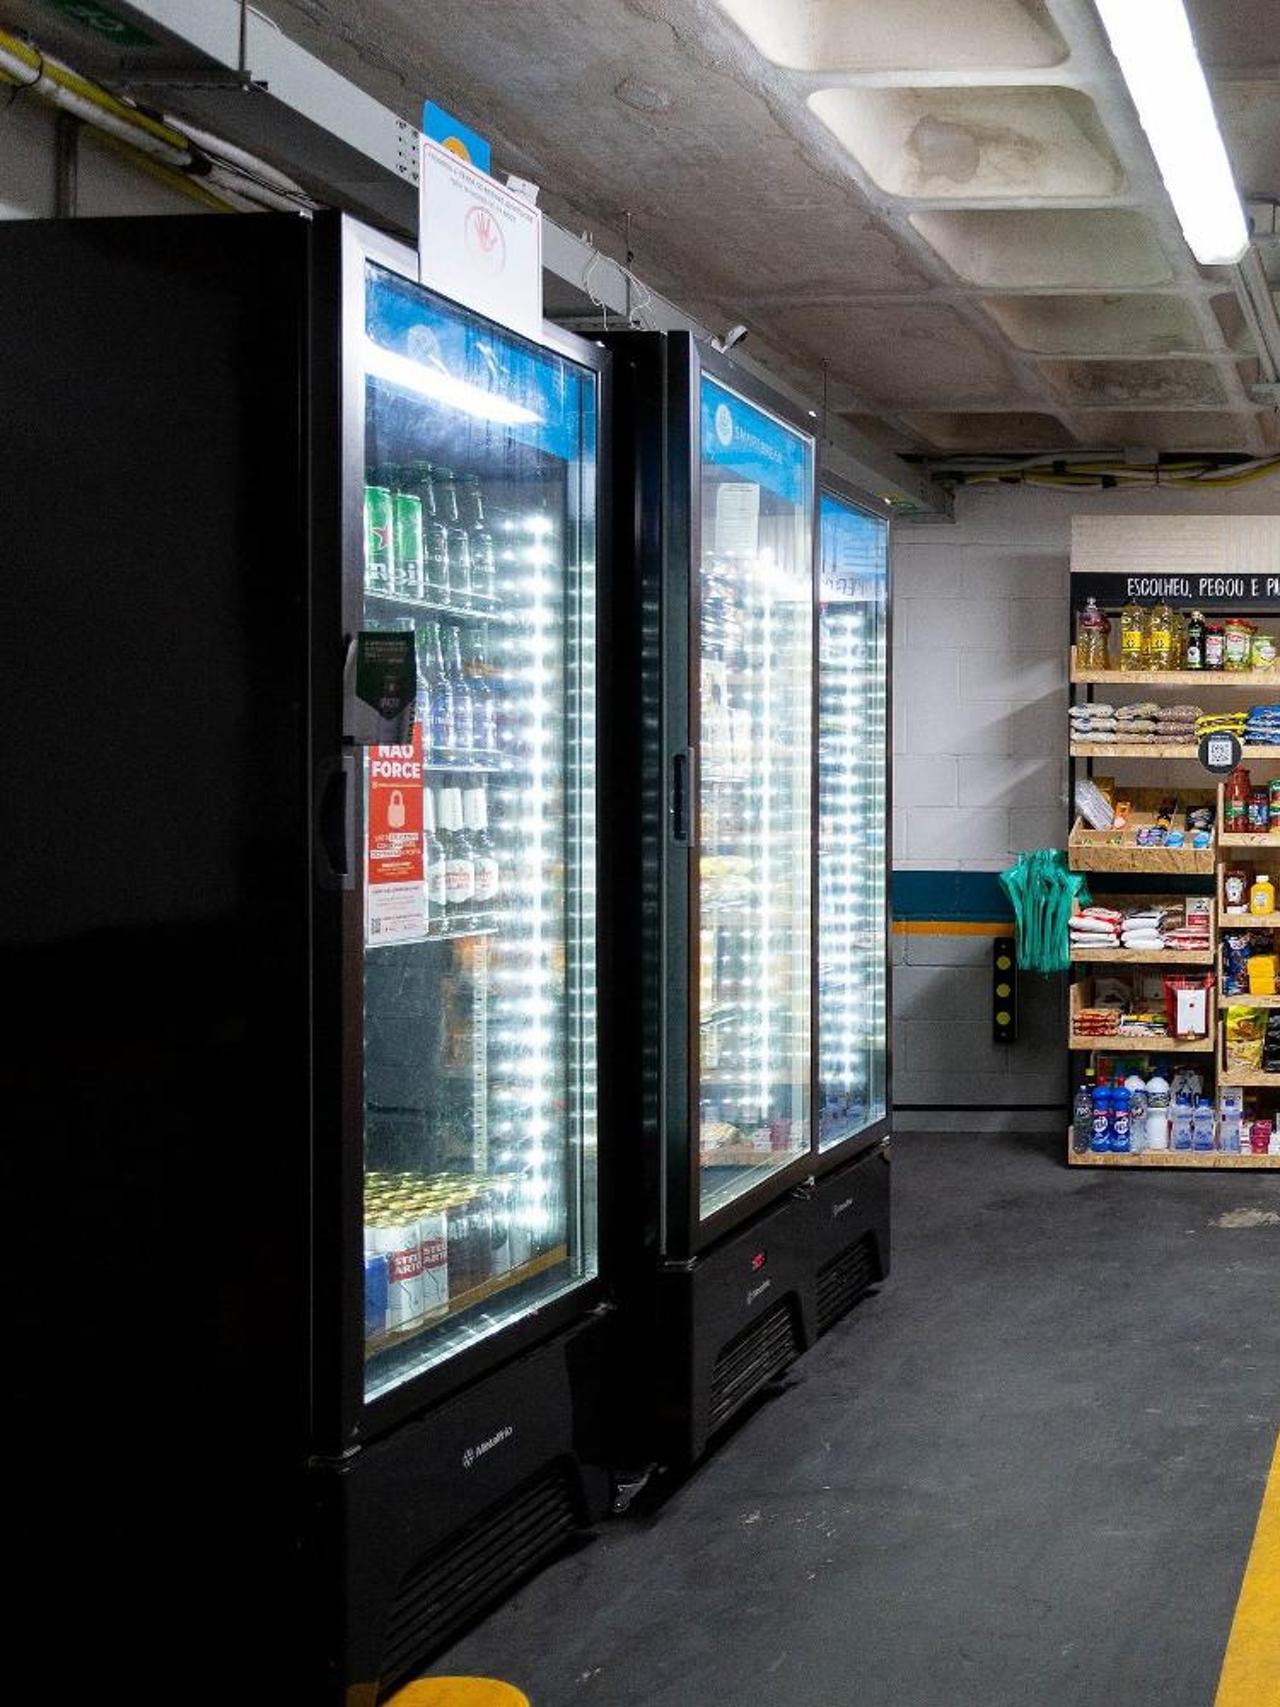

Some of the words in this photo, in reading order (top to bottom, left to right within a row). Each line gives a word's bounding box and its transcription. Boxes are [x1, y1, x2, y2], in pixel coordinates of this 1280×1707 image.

[1127, 578, 1192, 598] ESCOLHEU,
[1199, 578, 1245, 597] PEGOU
[1251, 578, 1259, 596] E
[371, 761, 421, 778] FORCE
